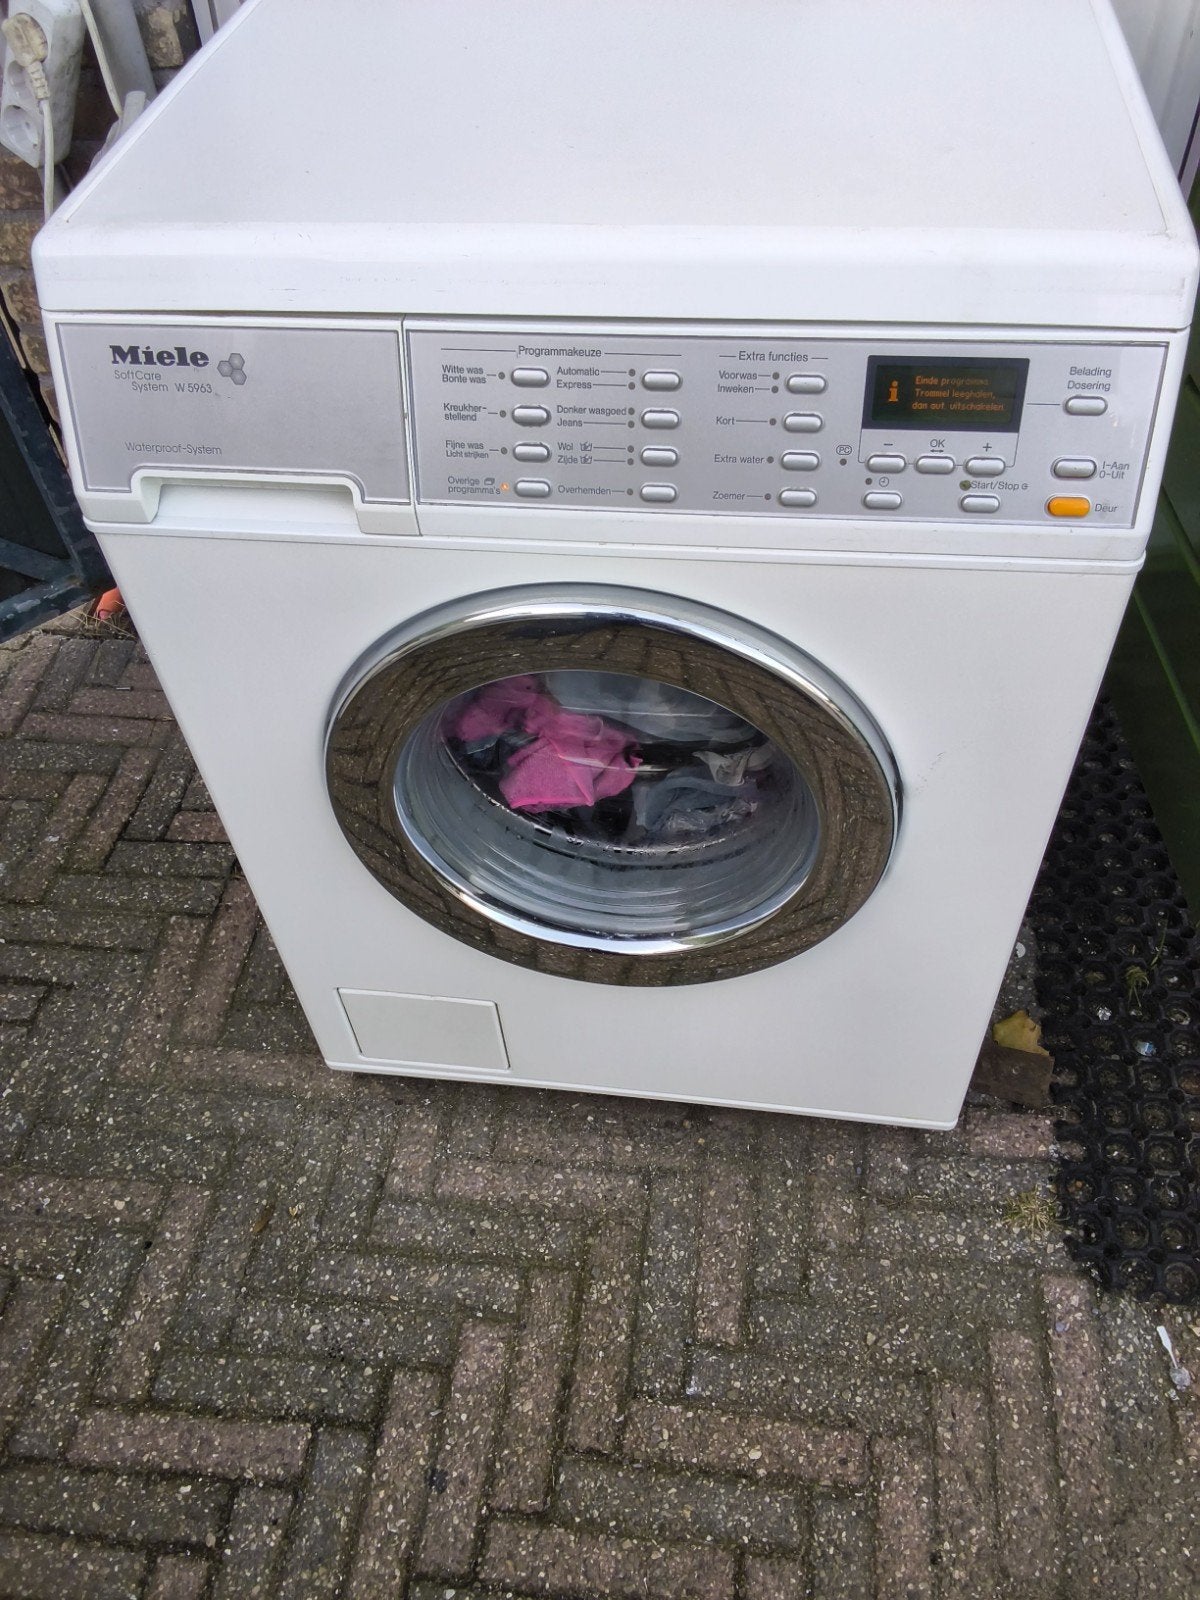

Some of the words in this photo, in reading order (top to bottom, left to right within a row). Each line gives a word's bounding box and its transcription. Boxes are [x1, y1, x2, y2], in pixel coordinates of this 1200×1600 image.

[518, 345, 602, 357] Programmakeuze
[109, 345, 210, 368] Miele
[738, 351, 766, 362] Extra
[768, 352, 808, 362] functies
[442, 364, 464, 374] Witte
[466, 366, 484, 374] was
[556, 366, 600, 377] Automatic
[1070, 366, 1112, 378] Belading
[114, 370, 162, 381] SoftCare
[442, 374, 468, 383] Bonte
[718, 370, 758, 380] Voorwas
[556, 380, 592, 390] Express
[916, 376, 938, 385] Einde
[131, 381, 169, 393] System
[175, 383, 187, 392] W
[188, 383, 213, 394] 5963
[718, 384, 754, 393] Inweken
[1067, 380, 1111, 392] Dosering
[915, 388, 950, 398] Trommel
[444, 403, 487, 412] Kreukher-
[556, 405, 586, 415] Donker
[588, 406, 627, 417] wasgoed
[912, 402, 928, 410] dan
[444, 412, 477, 422] stellend
[716, 416, 735, 426] Kort
[556, 418, 583, 427] Jeans
[125, 441, 222, 455] Waterproof-System
[446, 440, 466, 450] Fijne
[558, 442, 574, 451] Wol
[930, 439, 945, 448] OK
[464, 451, 489, 459] strijken
[558, 455, 578, 465] Zijde
[714, 454, 737, 463] Extra
[740, 456, 764, 464] water
[448, 476, 480, 486] Overige
[971, 480, 1020, 491] Start/Stop
[448, 486, 500, 494] programma's
[558, 485, 612, 496] Overhemden
[712, 492, 746, 500] Zoemer
[1094, 504, 1118, 513] Deur
